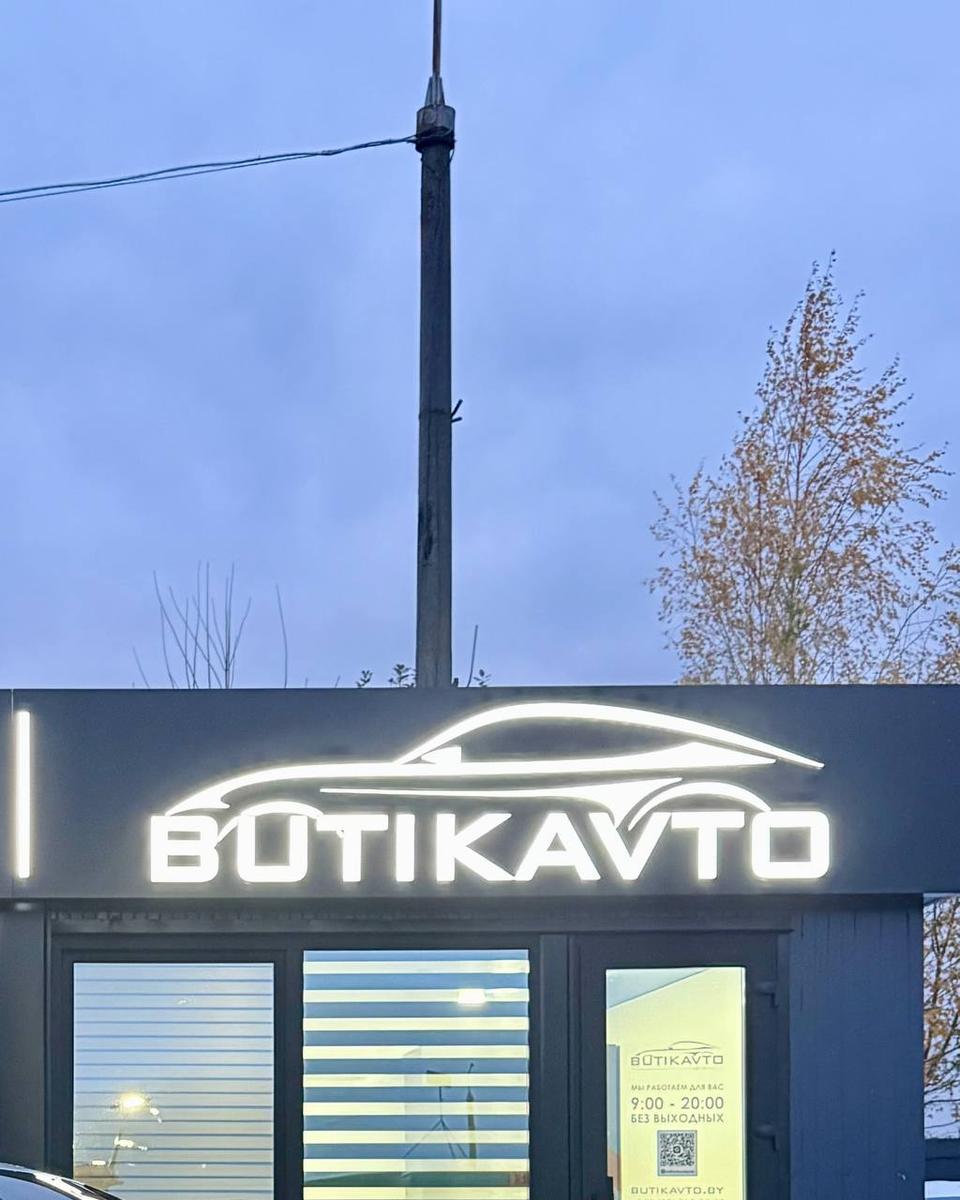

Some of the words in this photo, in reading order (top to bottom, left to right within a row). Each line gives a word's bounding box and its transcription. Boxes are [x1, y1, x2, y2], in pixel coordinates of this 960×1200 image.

[149, 811, 830, 883] BUTIKAVTO
[630, 1055, 724, 1066] BUTIKAVTO
[631, 1096, 664, 1110] 9:00
[680, 1096, 724, 1110] 20:00
[631, 1113, 650, 1123] БЕЗ
[653, 1113, 725, 1124] ВЫХОДНЫХ
[631, 1186, 724, 1195] BUTIKAVTO.BY
